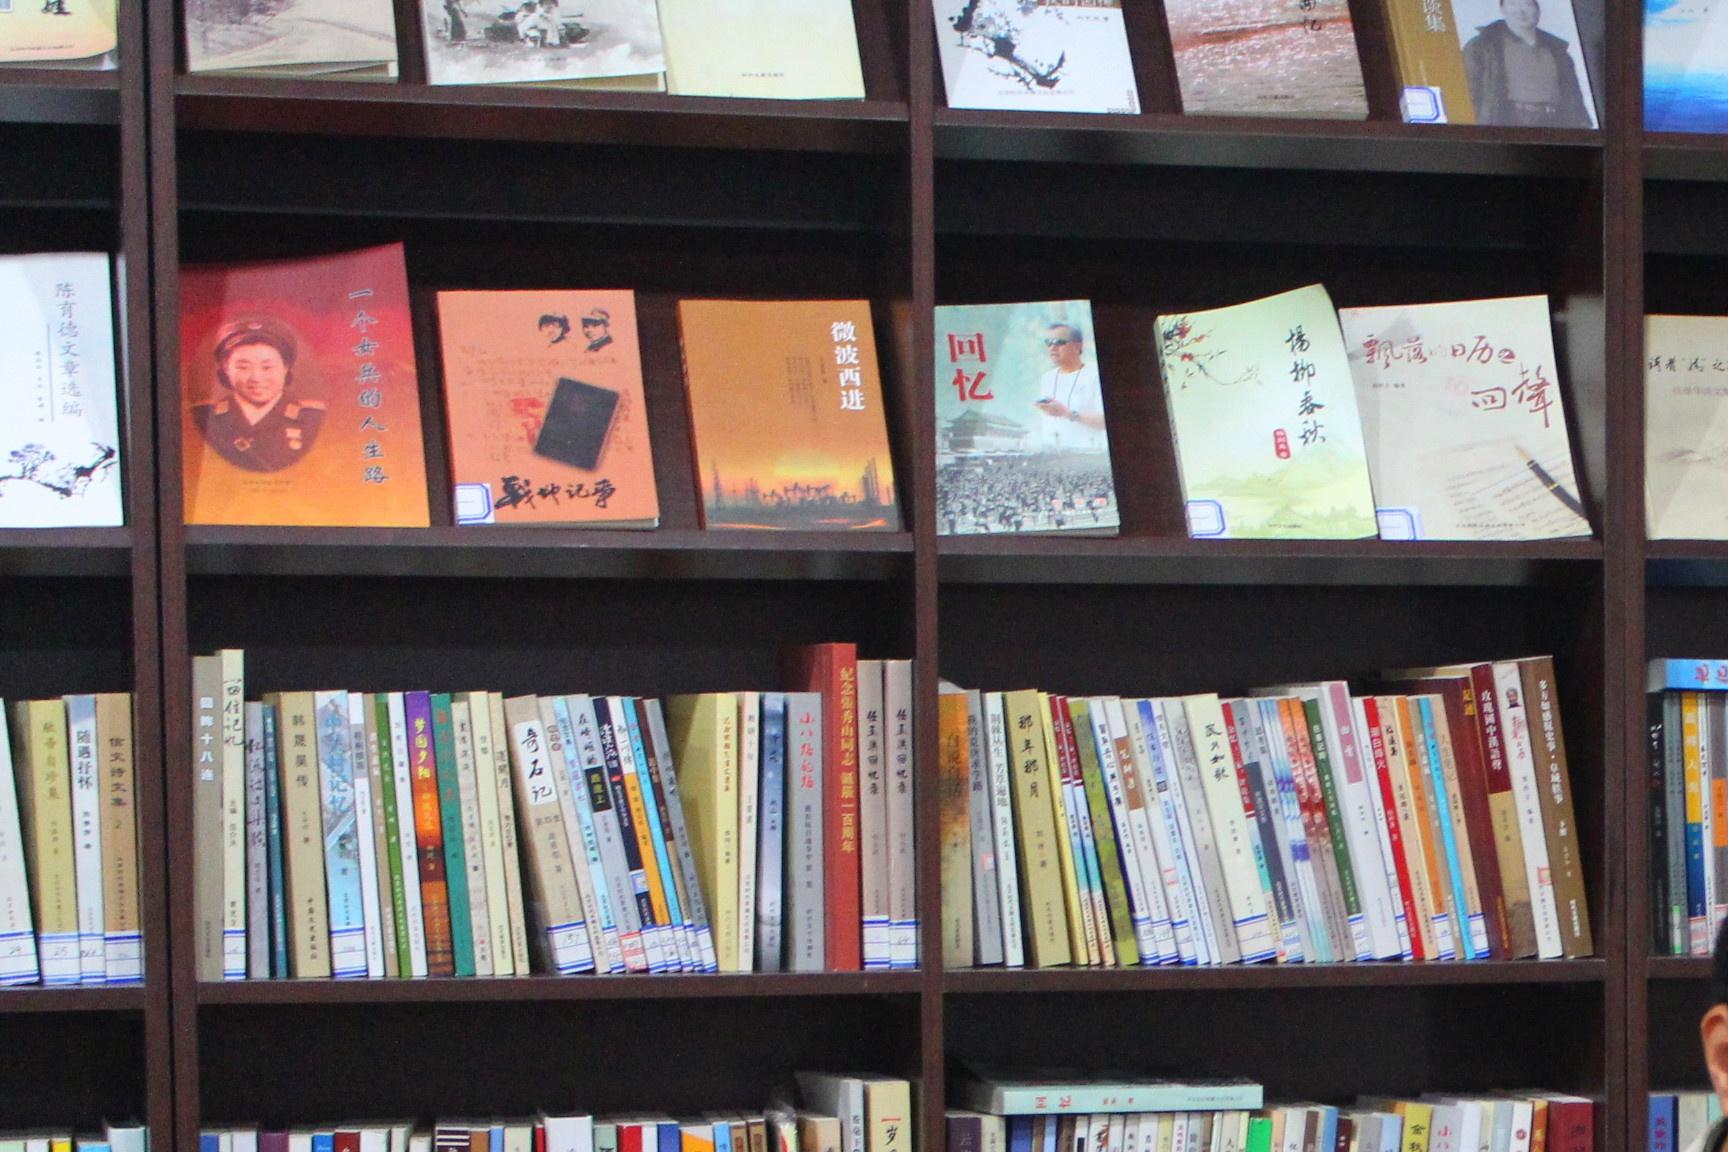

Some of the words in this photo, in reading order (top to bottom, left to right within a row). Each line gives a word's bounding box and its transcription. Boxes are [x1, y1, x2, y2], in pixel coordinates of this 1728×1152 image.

[830, 321, 866, 412] 微波西进
[946, 331, 994, 402] 回忆
